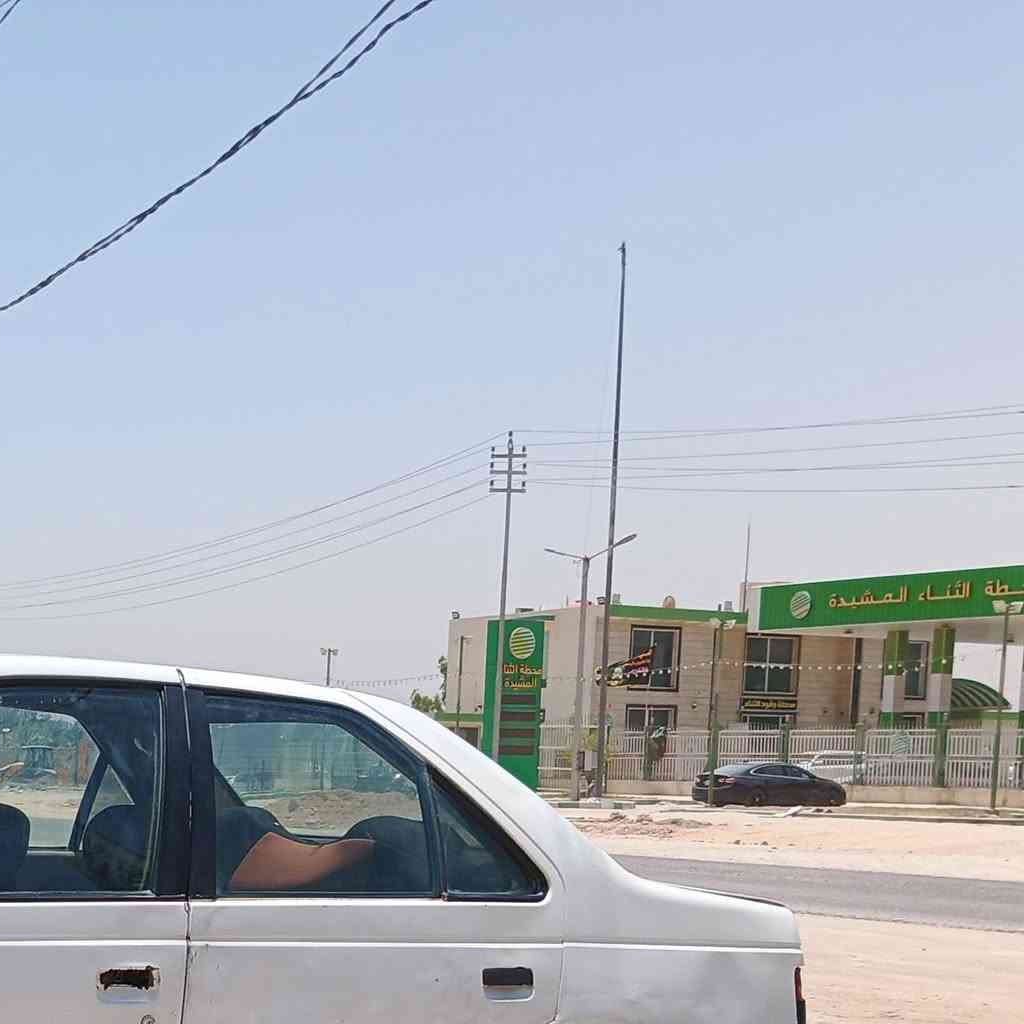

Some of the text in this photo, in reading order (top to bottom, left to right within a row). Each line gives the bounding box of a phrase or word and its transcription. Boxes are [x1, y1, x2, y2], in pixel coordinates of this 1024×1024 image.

[828, 578, 1024, 608] طة الثناء المشيدة
[503, 664, 518, 673] الثنا
